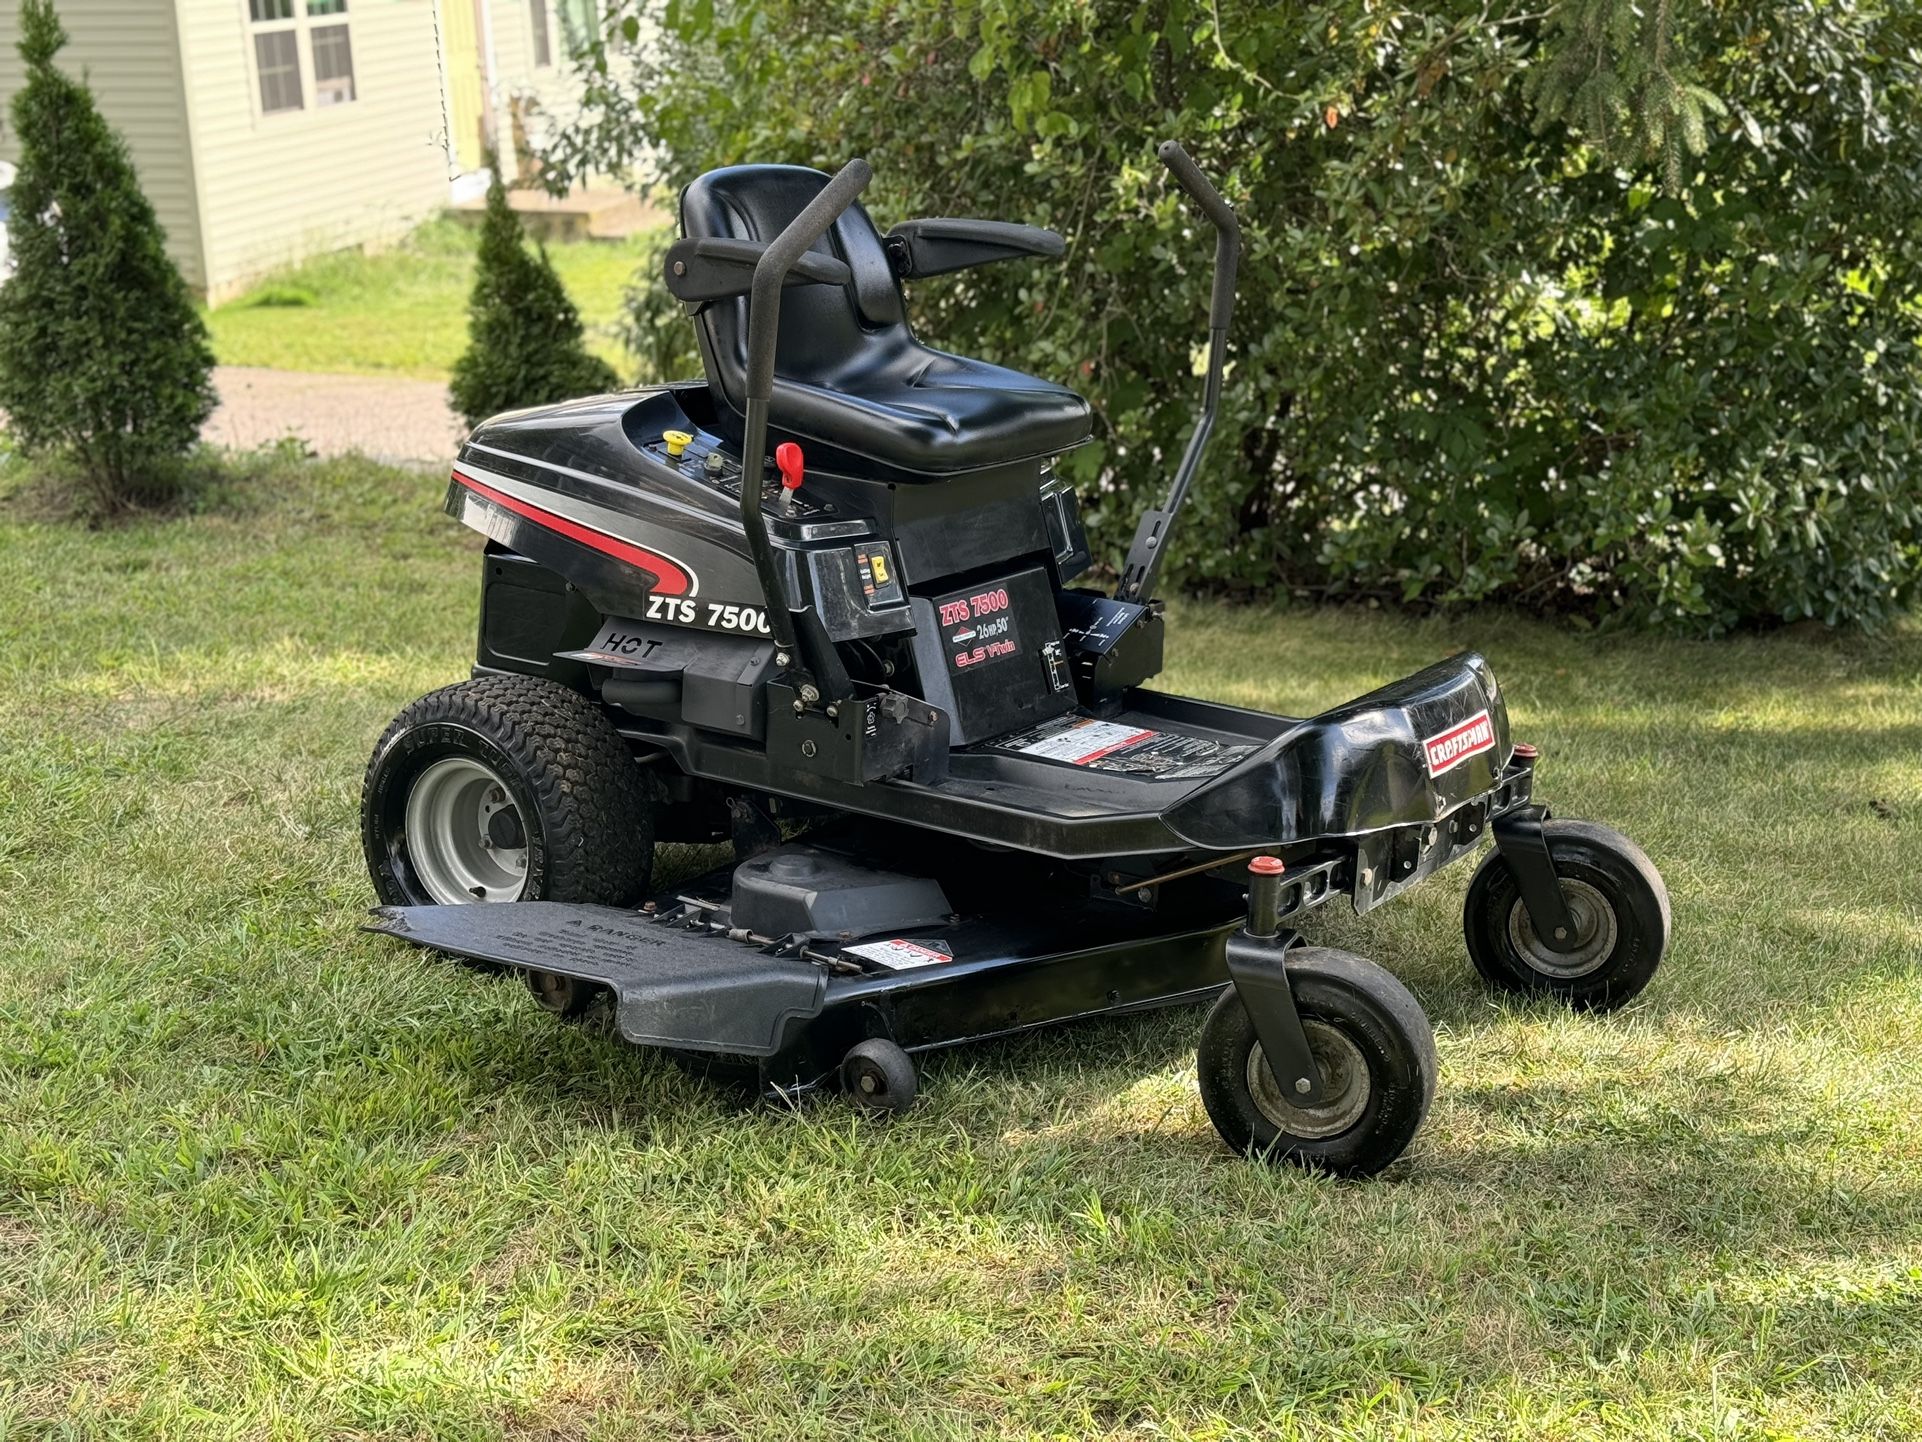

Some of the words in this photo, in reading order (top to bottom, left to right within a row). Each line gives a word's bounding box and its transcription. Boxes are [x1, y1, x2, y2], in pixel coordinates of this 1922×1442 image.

[646, 595, 697, 623] ZTS
[939, 600, 970, 627] ZTS
[970, 589, 1009, 617] 7500
[599, 632, 664, 659] HOT
[955, 646, 986, 668] ELS
[1430, 720, 1489, 766] CRAFTSMAN
